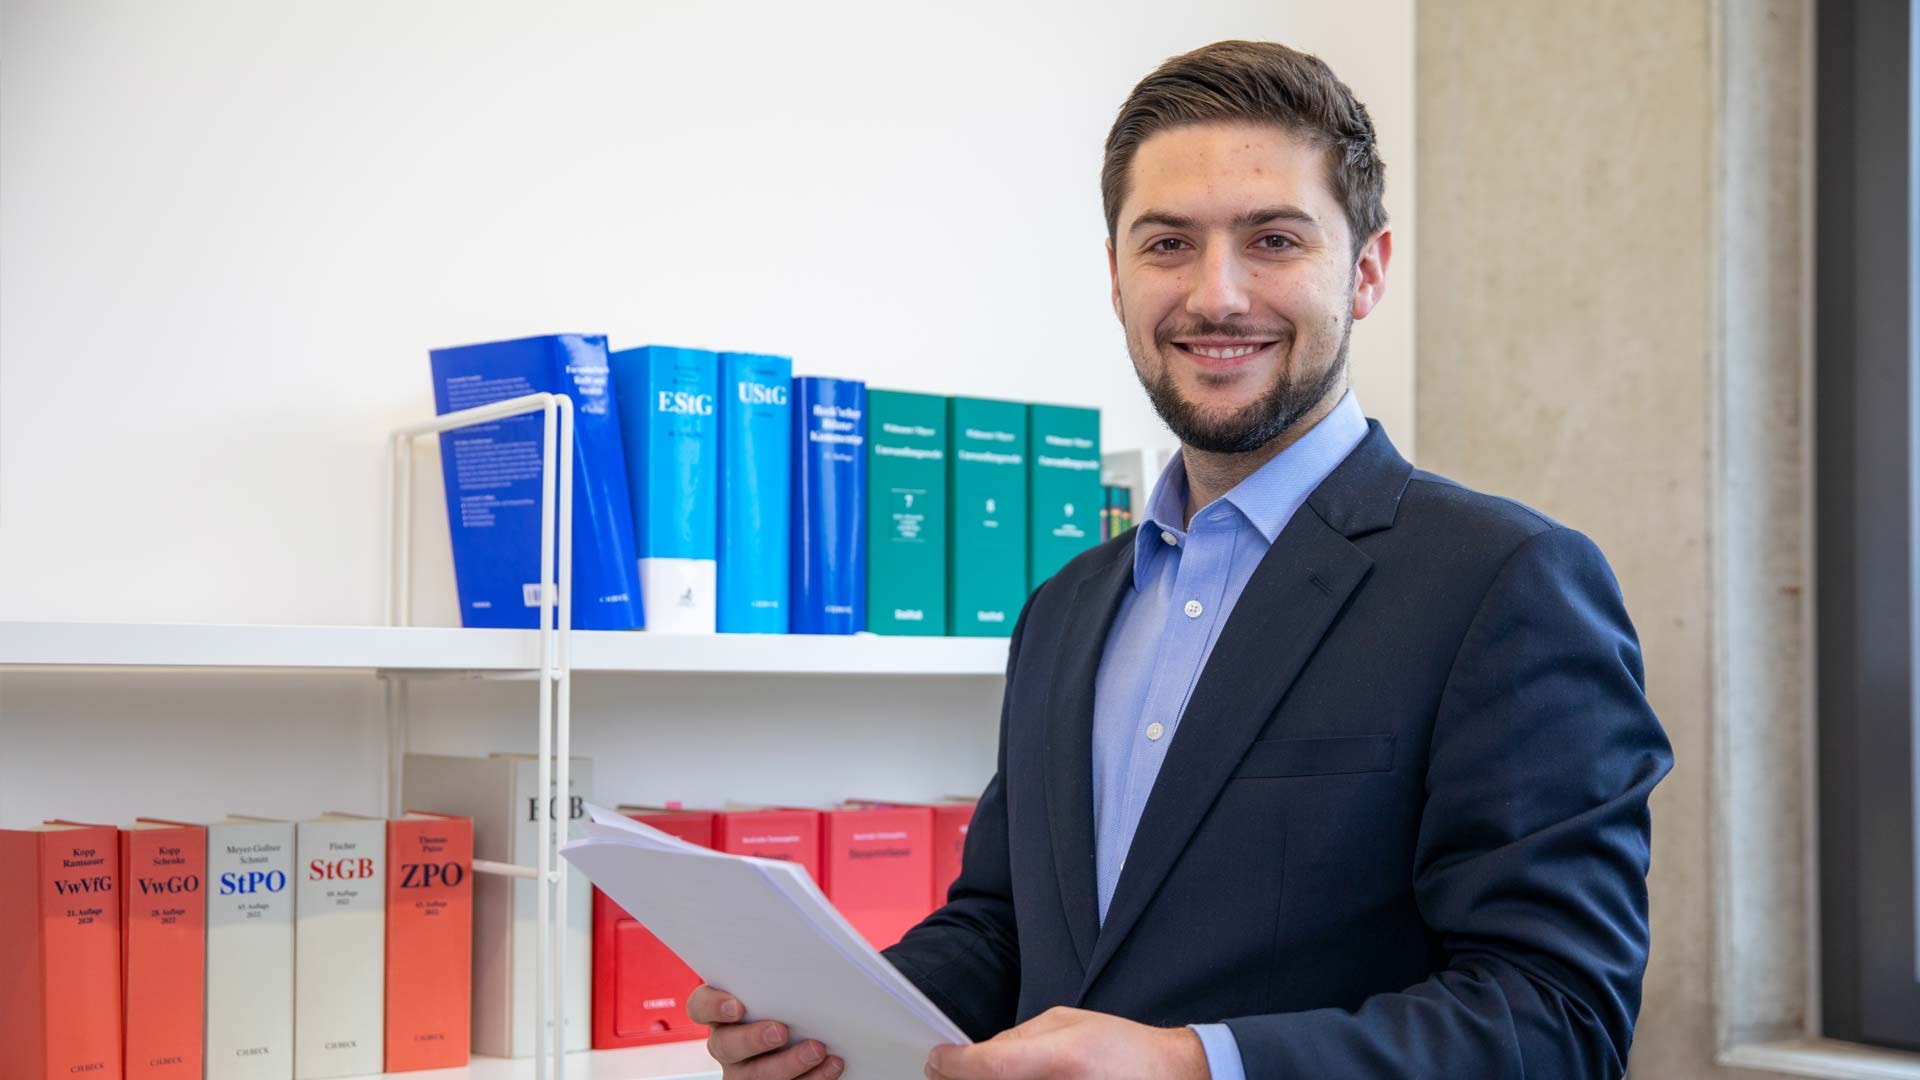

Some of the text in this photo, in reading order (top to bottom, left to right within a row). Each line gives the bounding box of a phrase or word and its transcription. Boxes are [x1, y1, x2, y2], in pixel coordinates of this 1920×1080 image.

[738, 381, 787, 406] UStG
[658, 390, 712, 415] EStG
[73, 848, 96, 858] Kopp
[159, 847, 181, 856] Kopp
[329, 842, 356, 851] Fischer
[63, 858, 104, 868] Ramsauer
[153, 857, 185, 866] Schenke
[240, 856, 269, 865] Schmitt
[309, 857, 374, 881] StGB
[400, 862, 464, 889] ZPO
[54, 876, 112, 896] VwVfG
[139, 875, 199, 895] VwGO
[220, 870, 286, 896] StPO
[79, 908, 103, 917] Auflage
